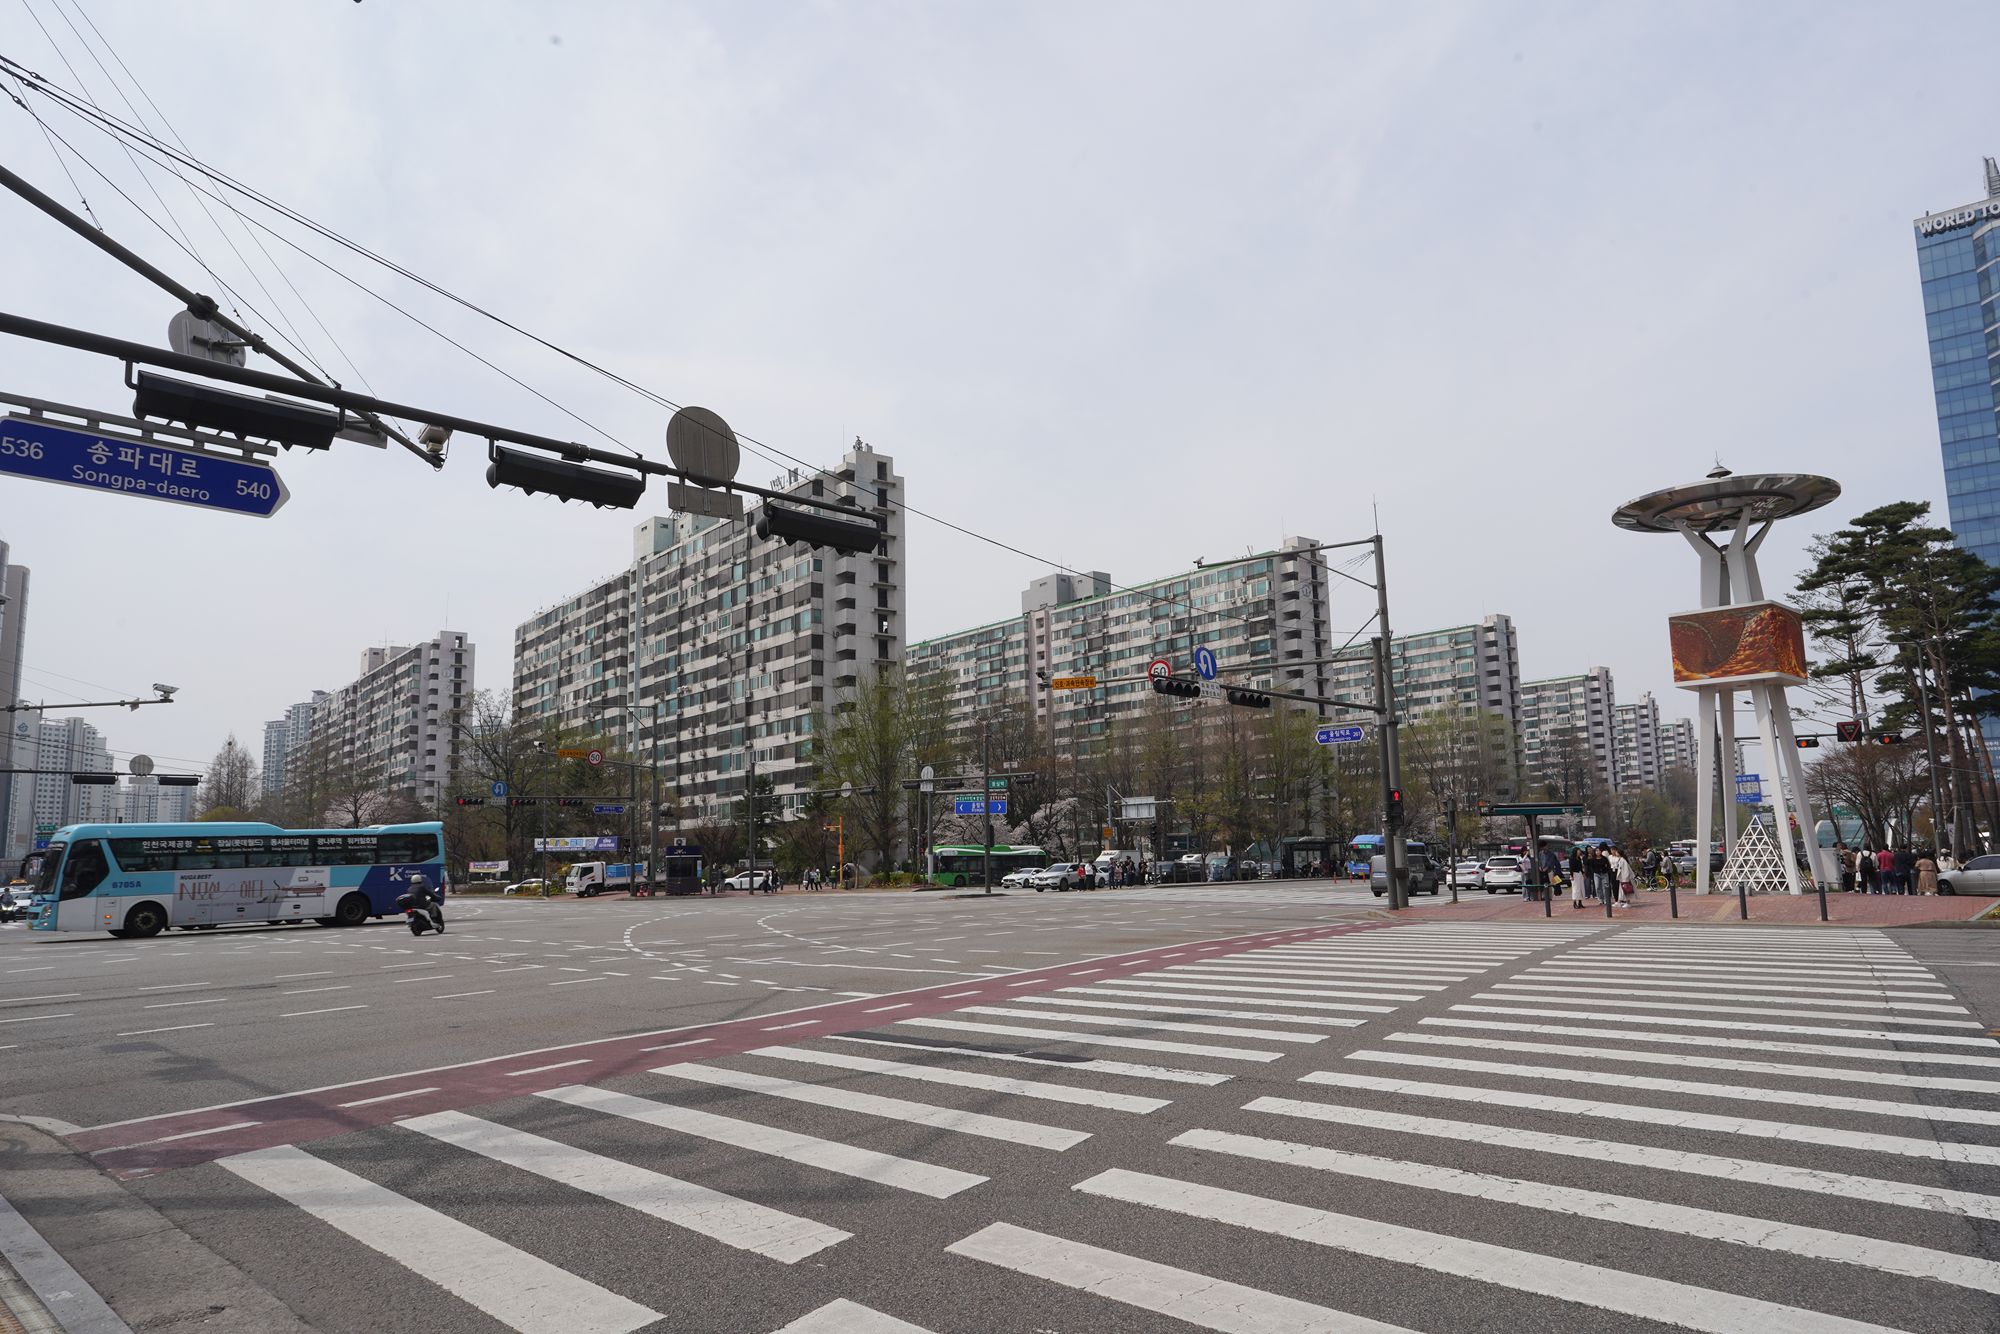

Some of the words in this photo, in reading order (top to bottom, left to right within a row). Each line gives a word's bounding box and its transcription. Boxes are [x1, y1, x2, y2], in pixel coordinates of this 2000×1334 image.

[1918, 209, 1976, 234] WORLD
[1, 436, 44, 460] 536
[87, 440, 201, 479] 송파대로
[72, 464, 210, 501] Songpa-daero
[236, 479, 271, 500] 540
[591, 753, 600, 762] 50
[142, 840, 193, 849] 인천국제공항
